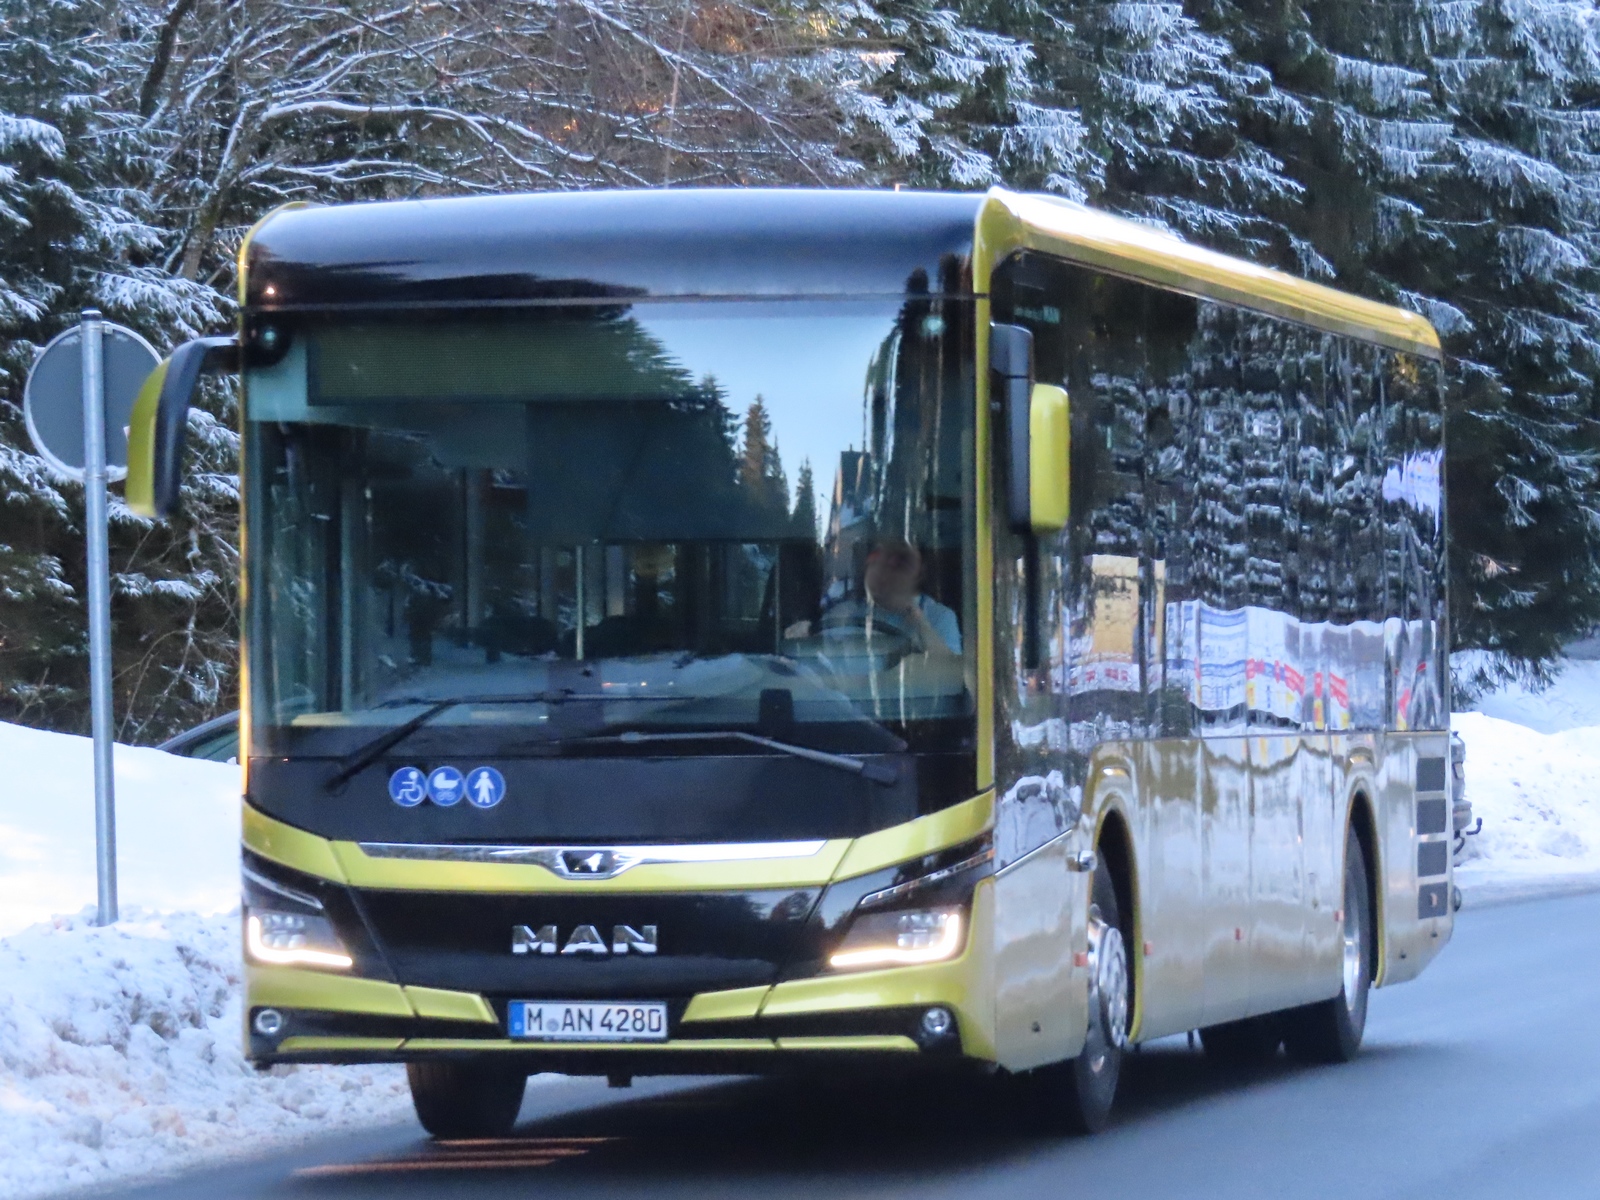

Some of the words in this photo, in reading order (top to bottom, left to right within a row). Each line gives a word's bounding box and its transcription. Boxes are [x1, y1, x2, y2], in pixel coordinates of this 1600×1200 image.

[512, 925, 657, 953] MAN
[527, 1008, 543, 1031] M
[562, 1008, 593, 1032] AN
[600, 1008, 662, 1033] 4280
